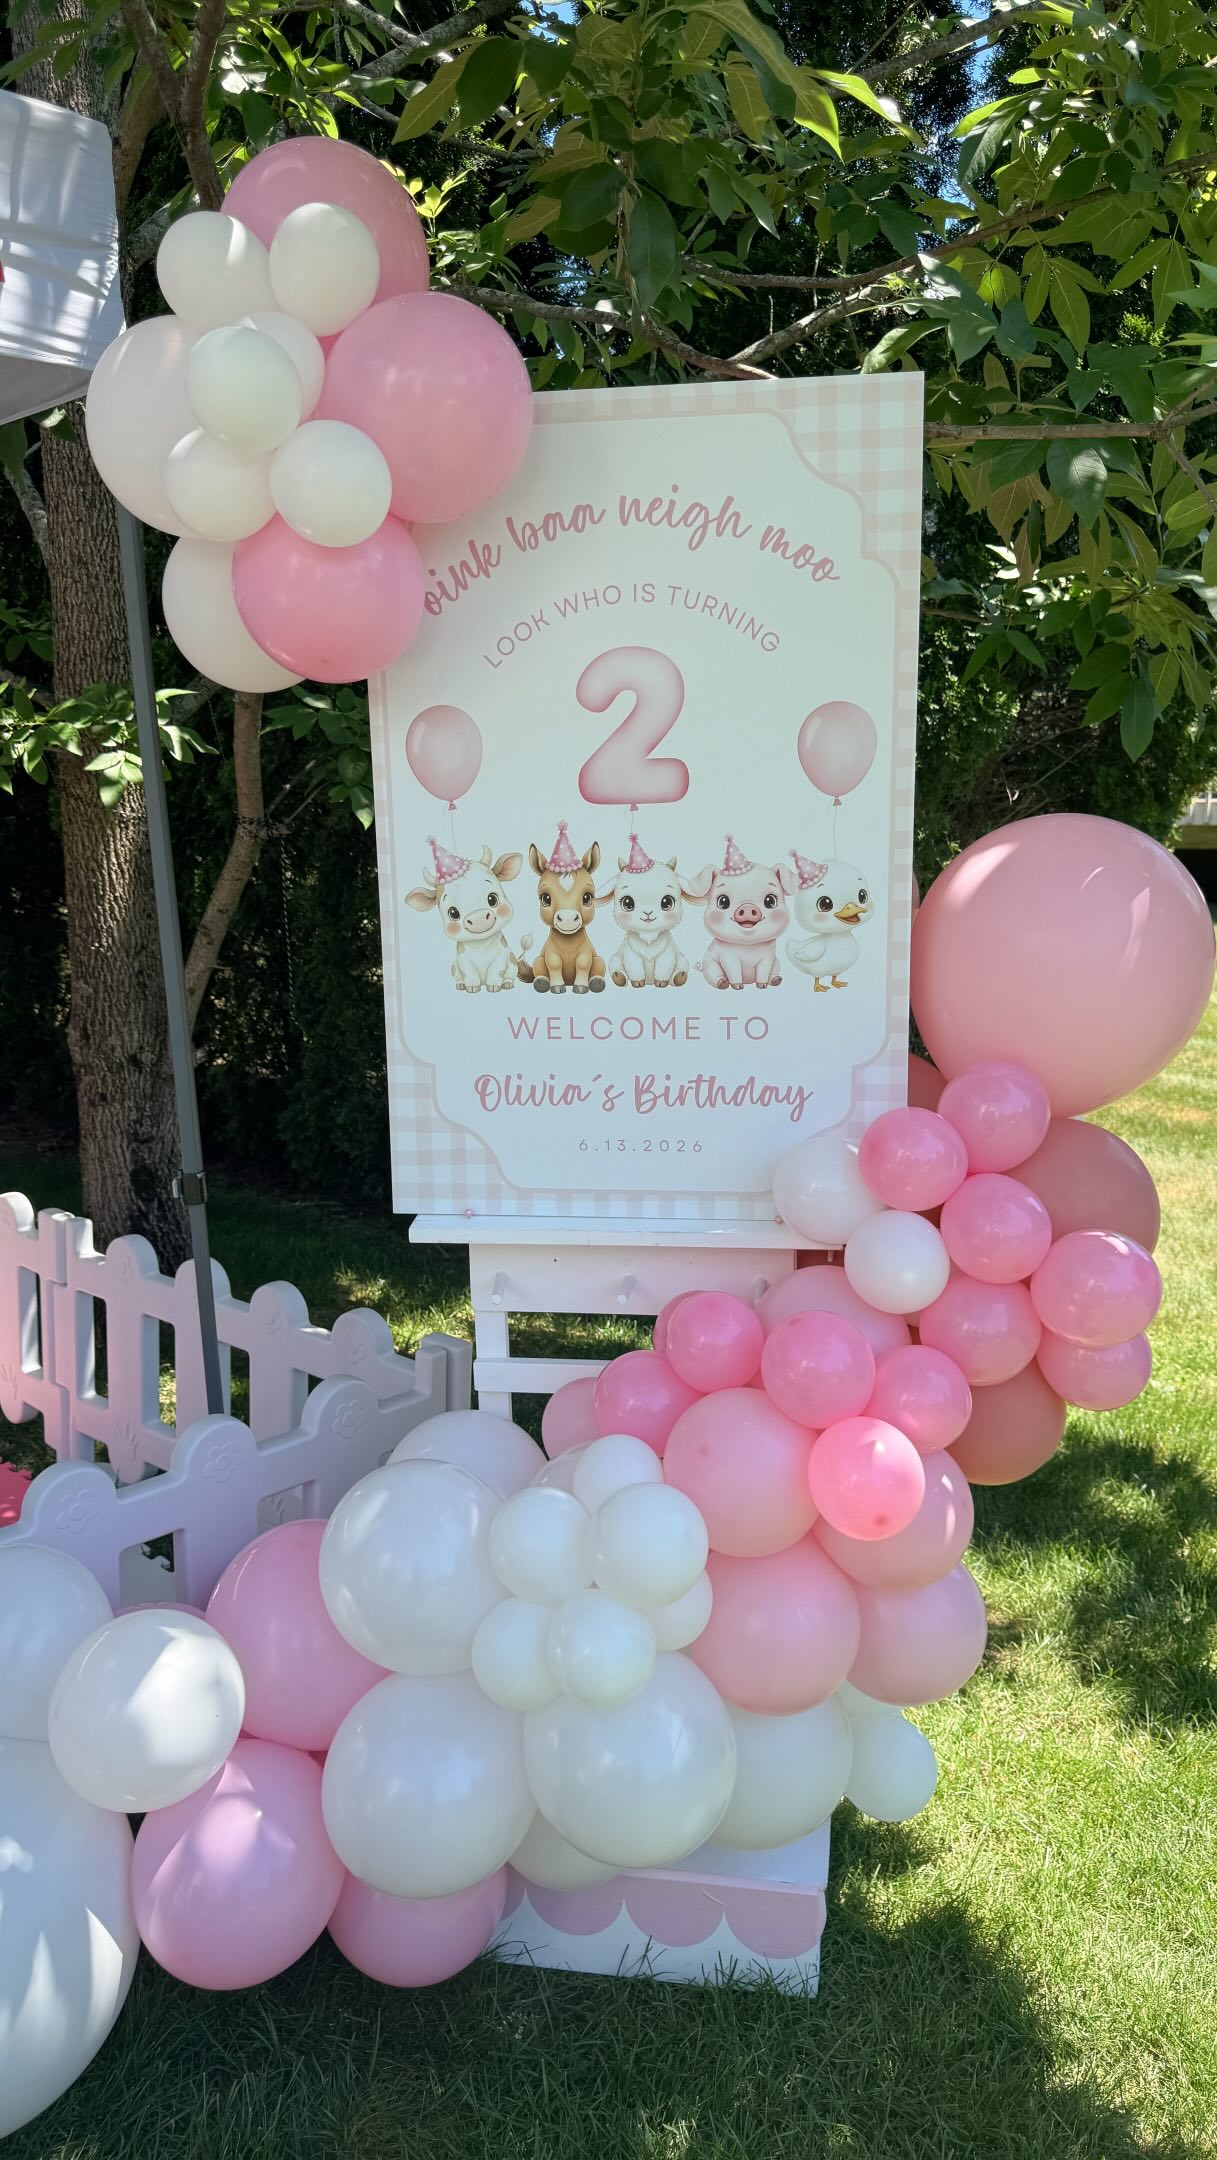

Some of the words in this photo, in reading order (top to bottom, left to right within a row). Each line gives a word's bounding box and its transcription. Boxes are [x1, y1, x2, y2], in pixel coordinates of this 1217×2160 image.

[424, 539, 501, 616] oink
[506, 503, 606, 552] baa
[618, 484, 752, 551] neigh
[759, 523, 840, 582] moo
[483, 609, 550, 669] LOOK
[553, 584, 621, 619] WHO
[633, 583, 656, 603] IS
[667, 585, 780, 652] TURNING
[574, 646, 688, 804] 2
[507, 1016, 701, 1040] WELCOME
[719, 1016, 770, 1040] TO
[633, 1073, 814, 1123] Birthday
[578, 1138, 703, 1153] 6.13.2026
